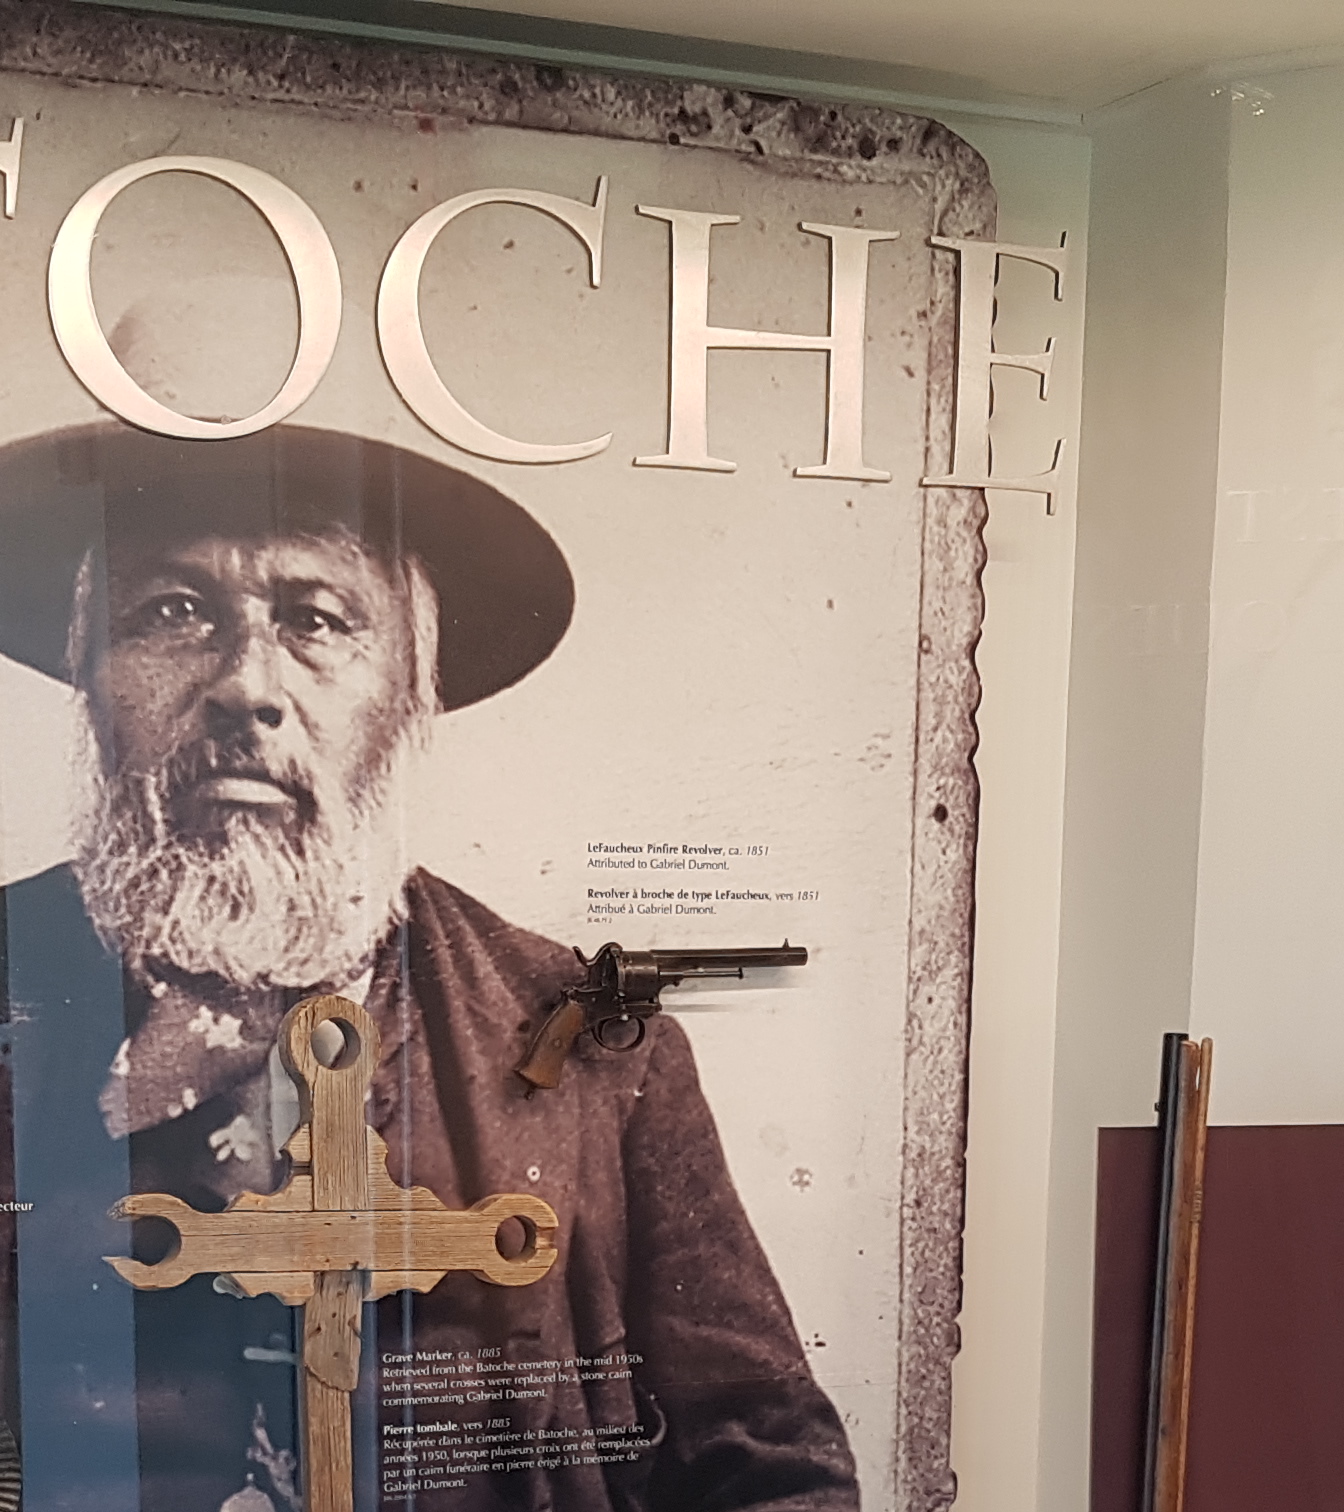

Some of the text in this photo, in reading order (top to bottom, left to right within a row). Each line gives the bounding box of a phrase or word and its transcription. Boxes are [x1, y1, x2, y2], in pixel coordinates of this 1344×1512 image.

[646, 842, 678, 854] Pinfire
[681, 843, 725, 856] Revolver,
[728, 847, 742, 855] ca.
[747, 845, 768, 855] 1851
[587, 856, 635, 869] Attributed
[637, 859, 647, 869] to
[649, 858, 685, 869] Gabriel
[587, 887, 629, 899] Revolver
[632, 888, 638, 899] à
[640, 888, 674, 899] broche
[677, 888, 689, 899] de
[691, 890, 712, 903] type
[775, 892, 793, 900] vers
[797, 890, 818, 900] 1851
[586, 902, 716, 915] Attribué à Gabriel Dumont.
